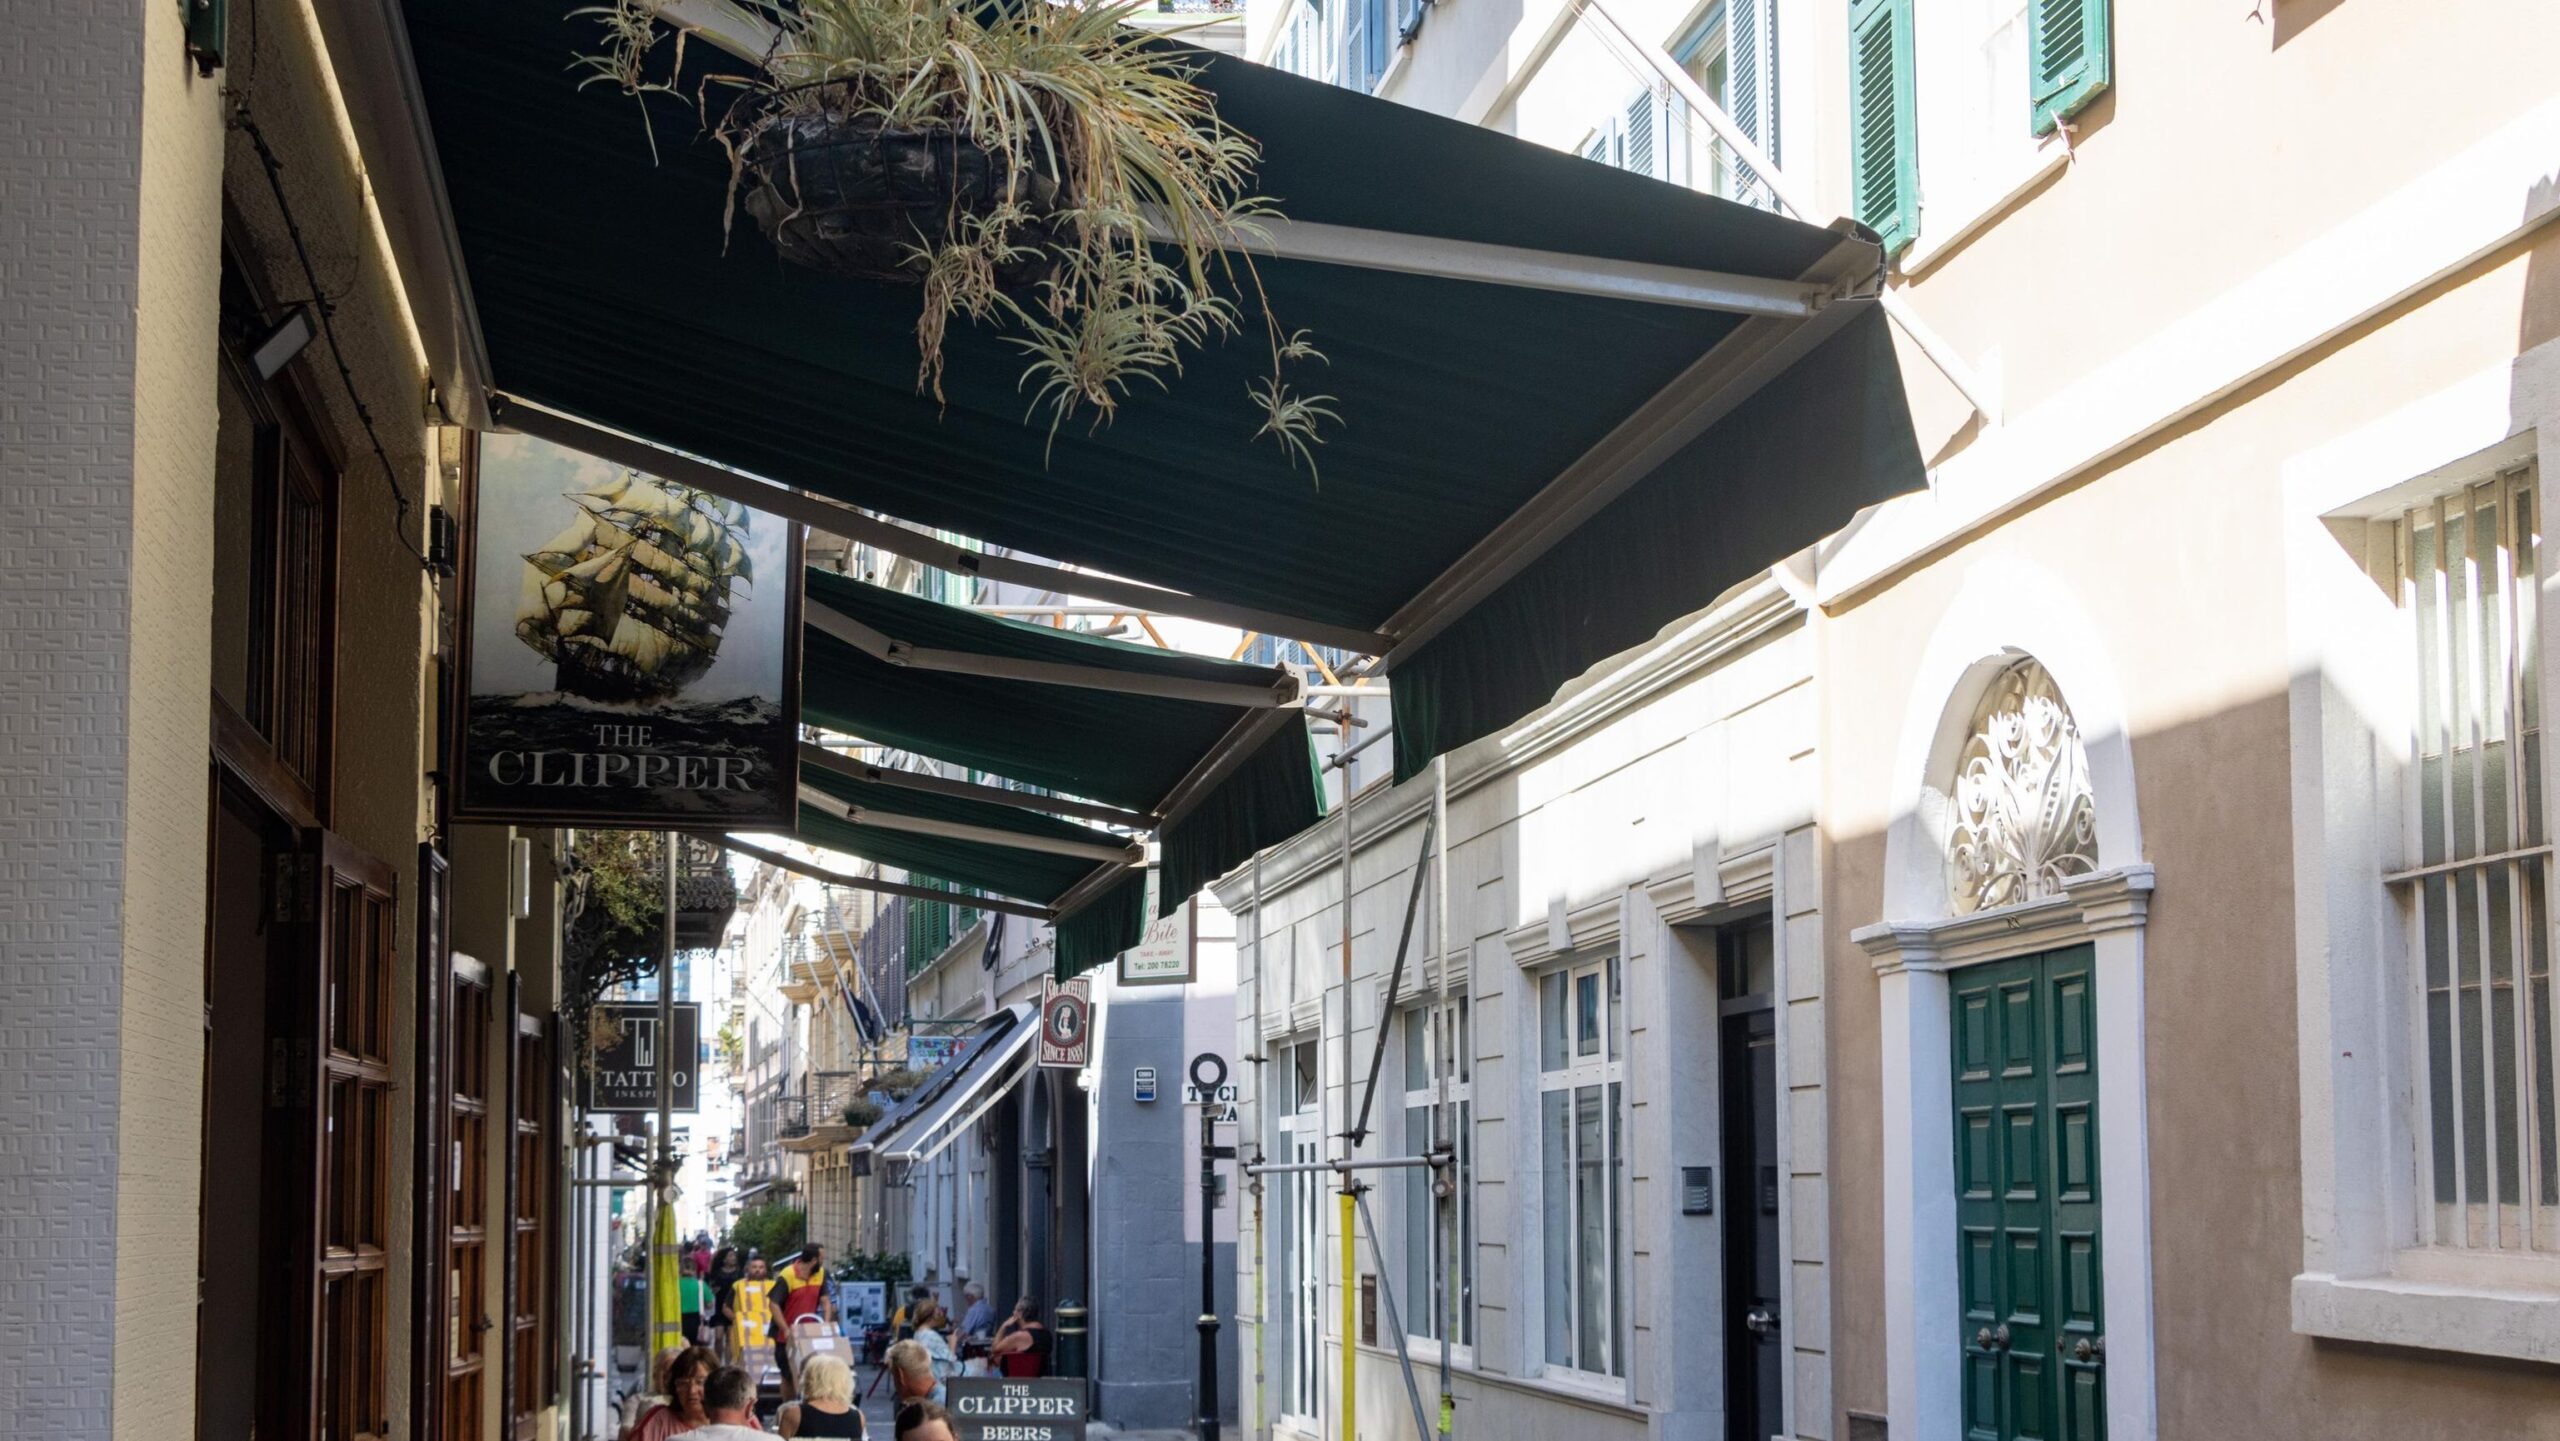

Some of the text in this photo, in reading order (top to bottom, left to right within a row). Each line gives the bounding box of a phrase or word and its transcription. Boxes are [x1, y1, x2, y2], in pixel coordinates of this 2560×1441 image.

[593, 723, 653, 747] THE
[489, 750, 756, 792] CLIPPER
[1141, 920, 1178, 945] Bite
[1042, 1040, 1066, 1062] SINCE
[601, 1071, 688, 1087] TATTO
[1002, 1384, 1030, 1397] THE
[958, 1396, 1076, 1416] CLIPPER
[982, 1426, 1052, 1441] BEERS
